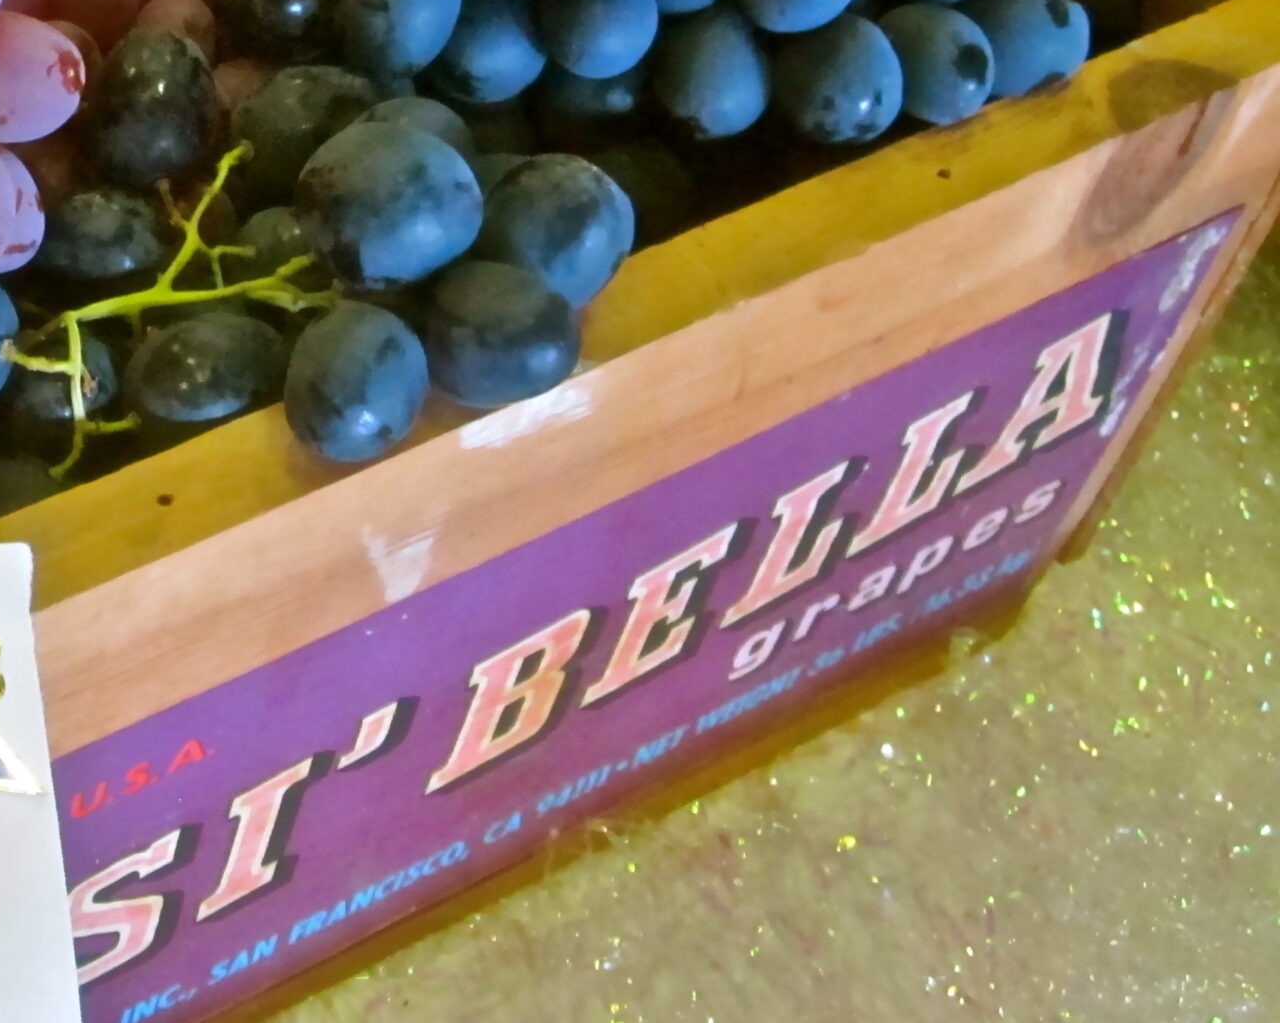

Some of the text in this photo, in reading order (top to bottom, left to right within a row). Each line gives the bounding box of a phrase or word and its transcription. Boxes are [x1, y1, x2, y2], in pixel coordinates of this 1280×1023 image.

[425, 310, 1114, 796] BELLA
[727, 479, 1063, 681] grapes
[70, 739, 215, 818] U.S.A.
[207, 933, 279, 986] SAN
[288, 840, 470, 945] FRANCISCO,
[482, 811, 523, 844] CA
[631, 725, 691, 768] NET
